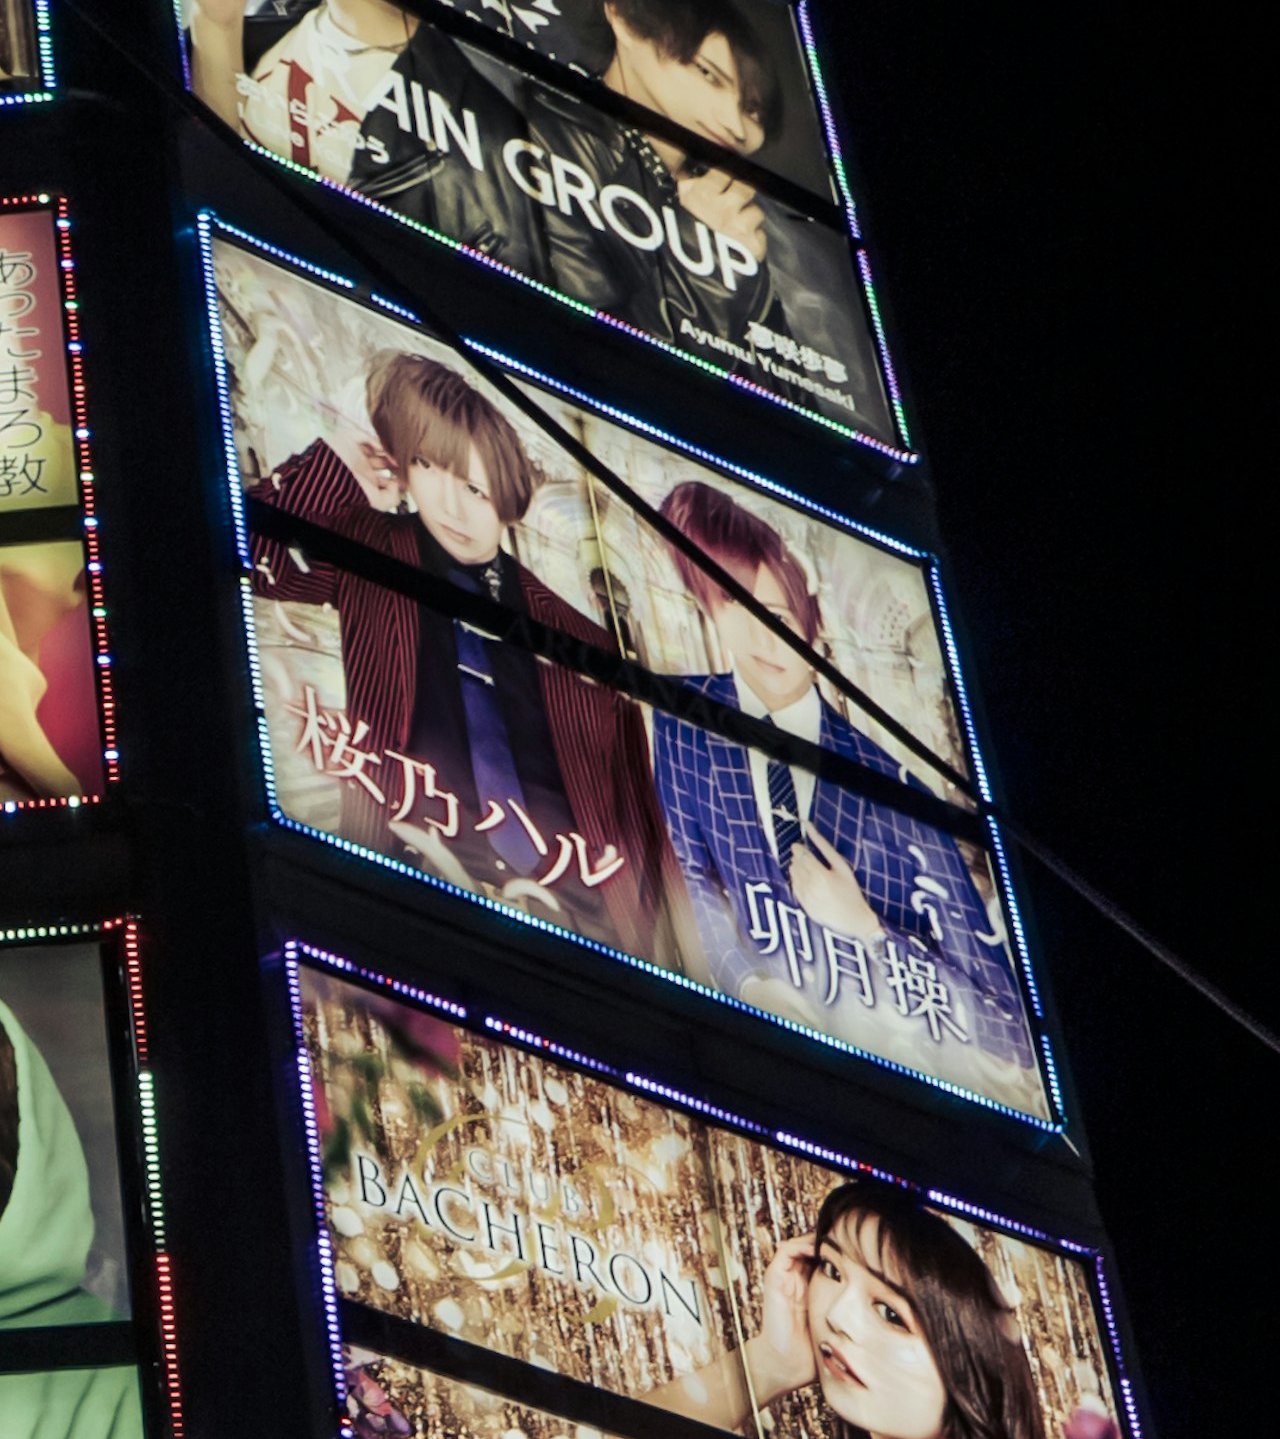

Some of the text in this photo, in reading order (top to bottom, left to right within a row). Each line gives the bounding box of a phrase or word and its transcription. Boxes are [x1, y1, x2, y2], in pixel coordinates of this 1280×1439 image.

[504, 134, 759, 293] GROUP
[744, 882, 970, 1044] 卯月操
[347, 1153, 703, 1328] BACHERON
